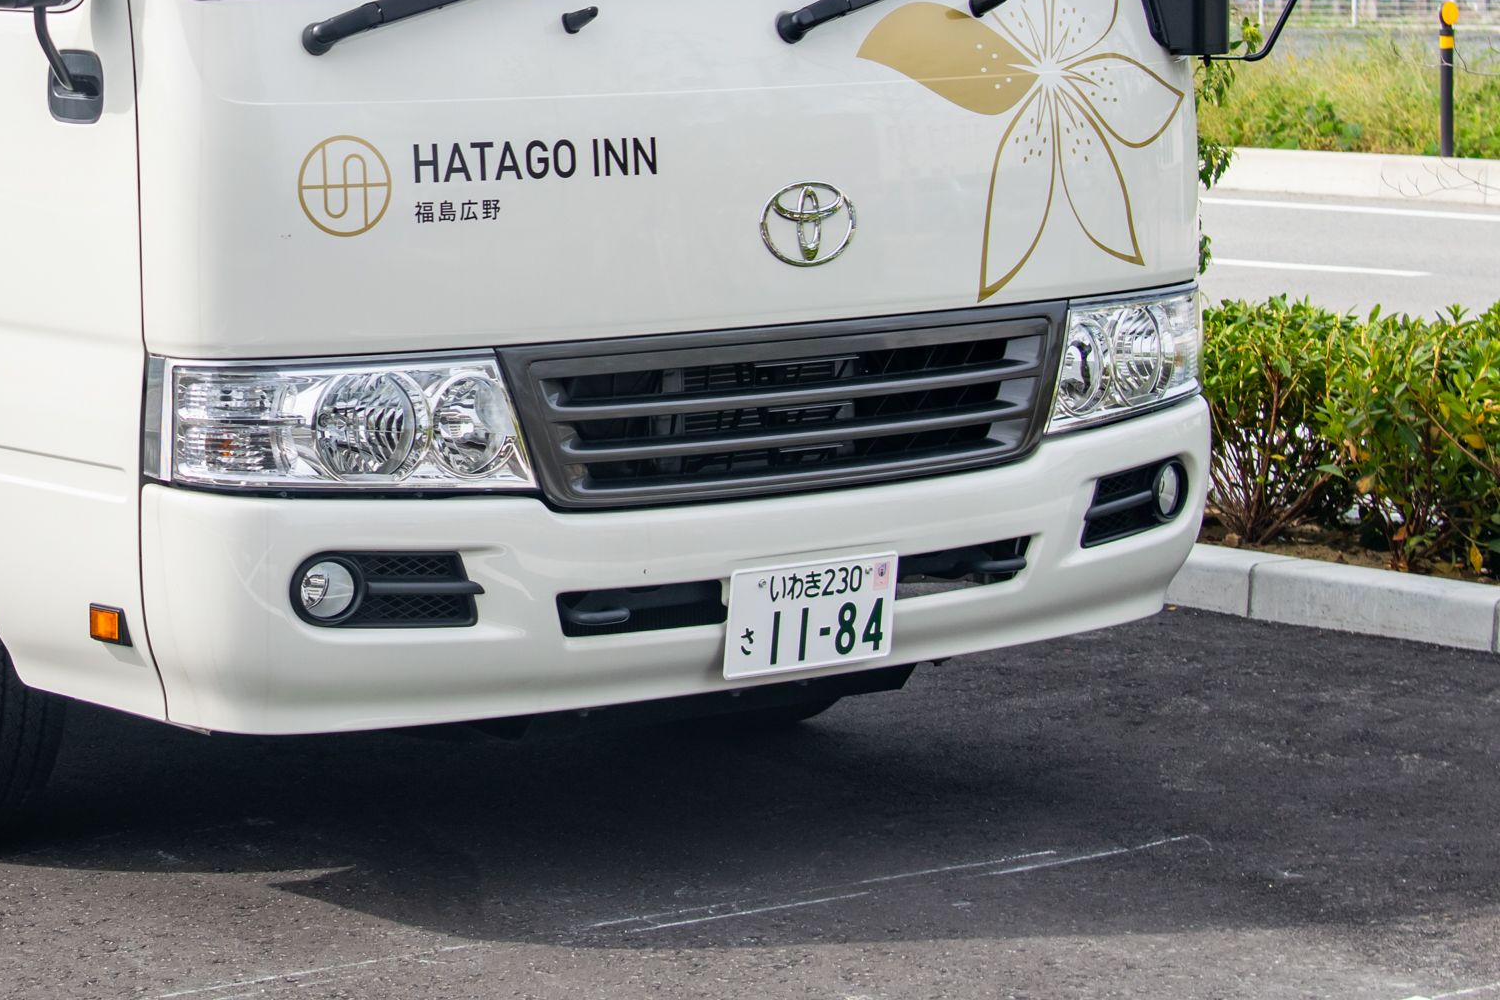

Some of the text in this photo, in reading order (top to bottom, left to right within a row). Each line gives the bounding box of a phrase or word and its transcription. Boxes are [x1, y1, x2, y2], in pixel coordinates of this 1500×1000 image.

[412, 136, 658, 184] HATAGO INN
[414, 199, 501, 224] 福島広野
[740, 597, 884, 666] さ 11-84
